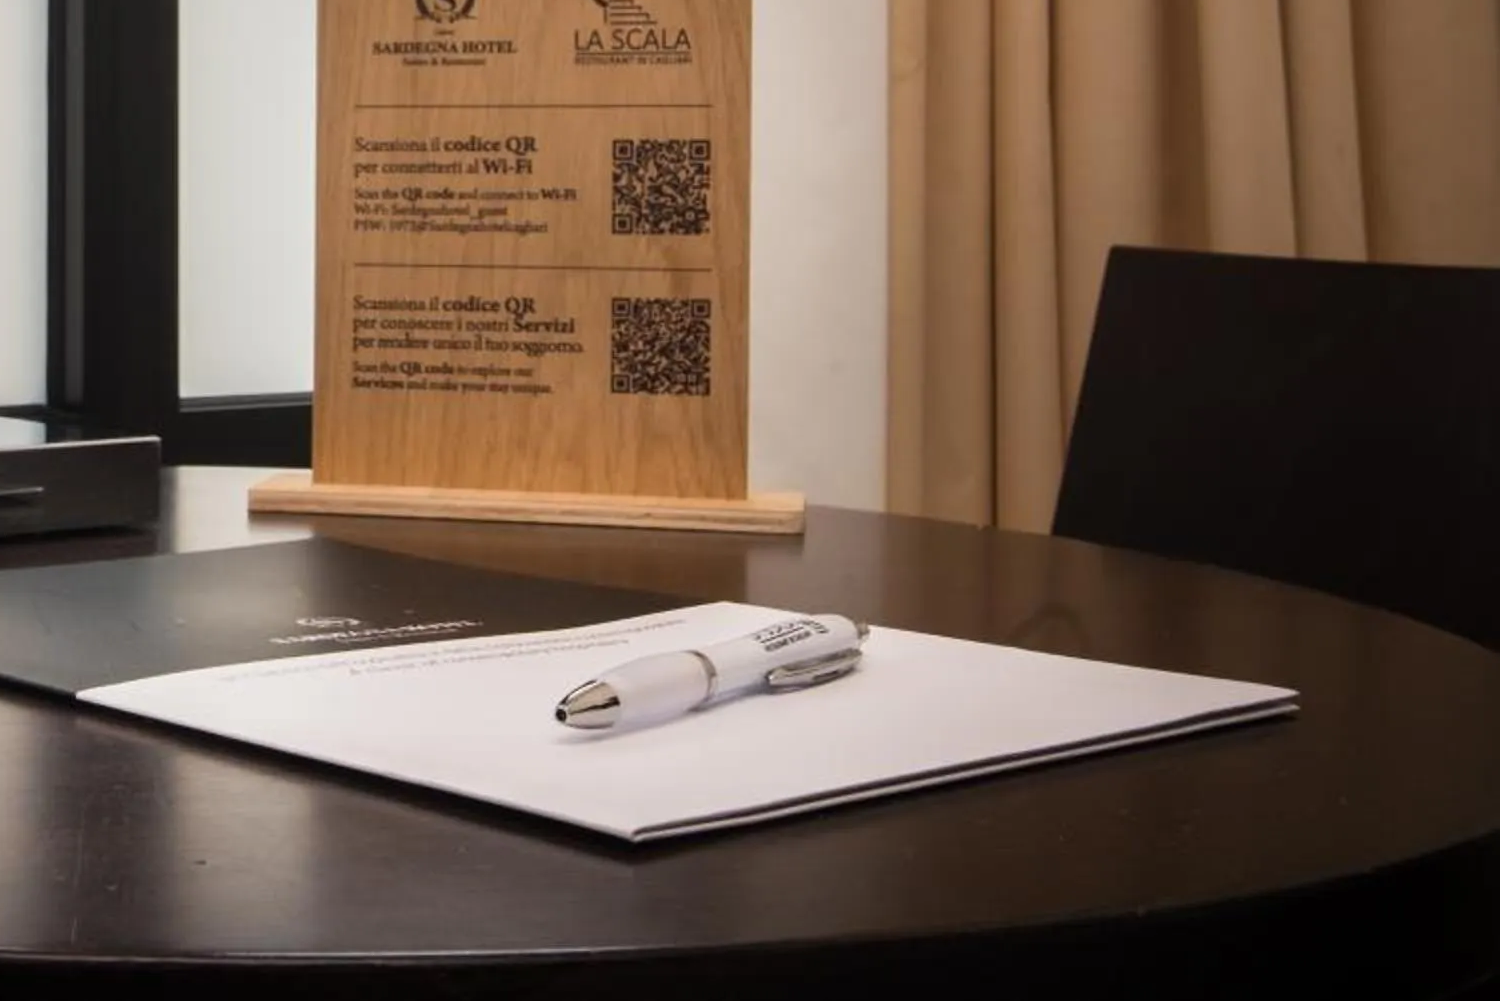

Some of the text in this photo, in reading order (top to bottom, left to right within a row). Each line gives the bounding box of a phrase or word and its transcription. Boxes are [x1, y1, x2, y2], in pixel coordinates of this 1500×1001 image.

[574, 27, 691, 50] LA SCALA
[372, 40, 517, 55] SARDEGNA HOTEL
[355, 136, 538, 155] Scansiona il codice QR
[354, 162, 377, 178] per
[466, 159, 479, 174] al
[482, 159, 533, 174] Wi-Fi
[402, 187, 423, 202] QR
[426, 187, 454, 200] code
[541, 188, 577, 200] Wi-Fi
[353, 296, 536, 317] Scansiona il codice QR
[353, 318, 377, 333] per
[380, 319, 454, 331] conoscere
[465, 318, 509, 332] nostri
[512, 318, 575, 333] Servizi
[353, 337, 375, 352] per
[378, 332, 430, 349] rendere
[433, 336, 471, 350] unico
[474, 334, 483, 351] il
[485, 338, 509, 351] tuo
[400, 361, 422, 376] QR
[424, 361, 454, 375] code
[352, 376, 404, 390] Services
